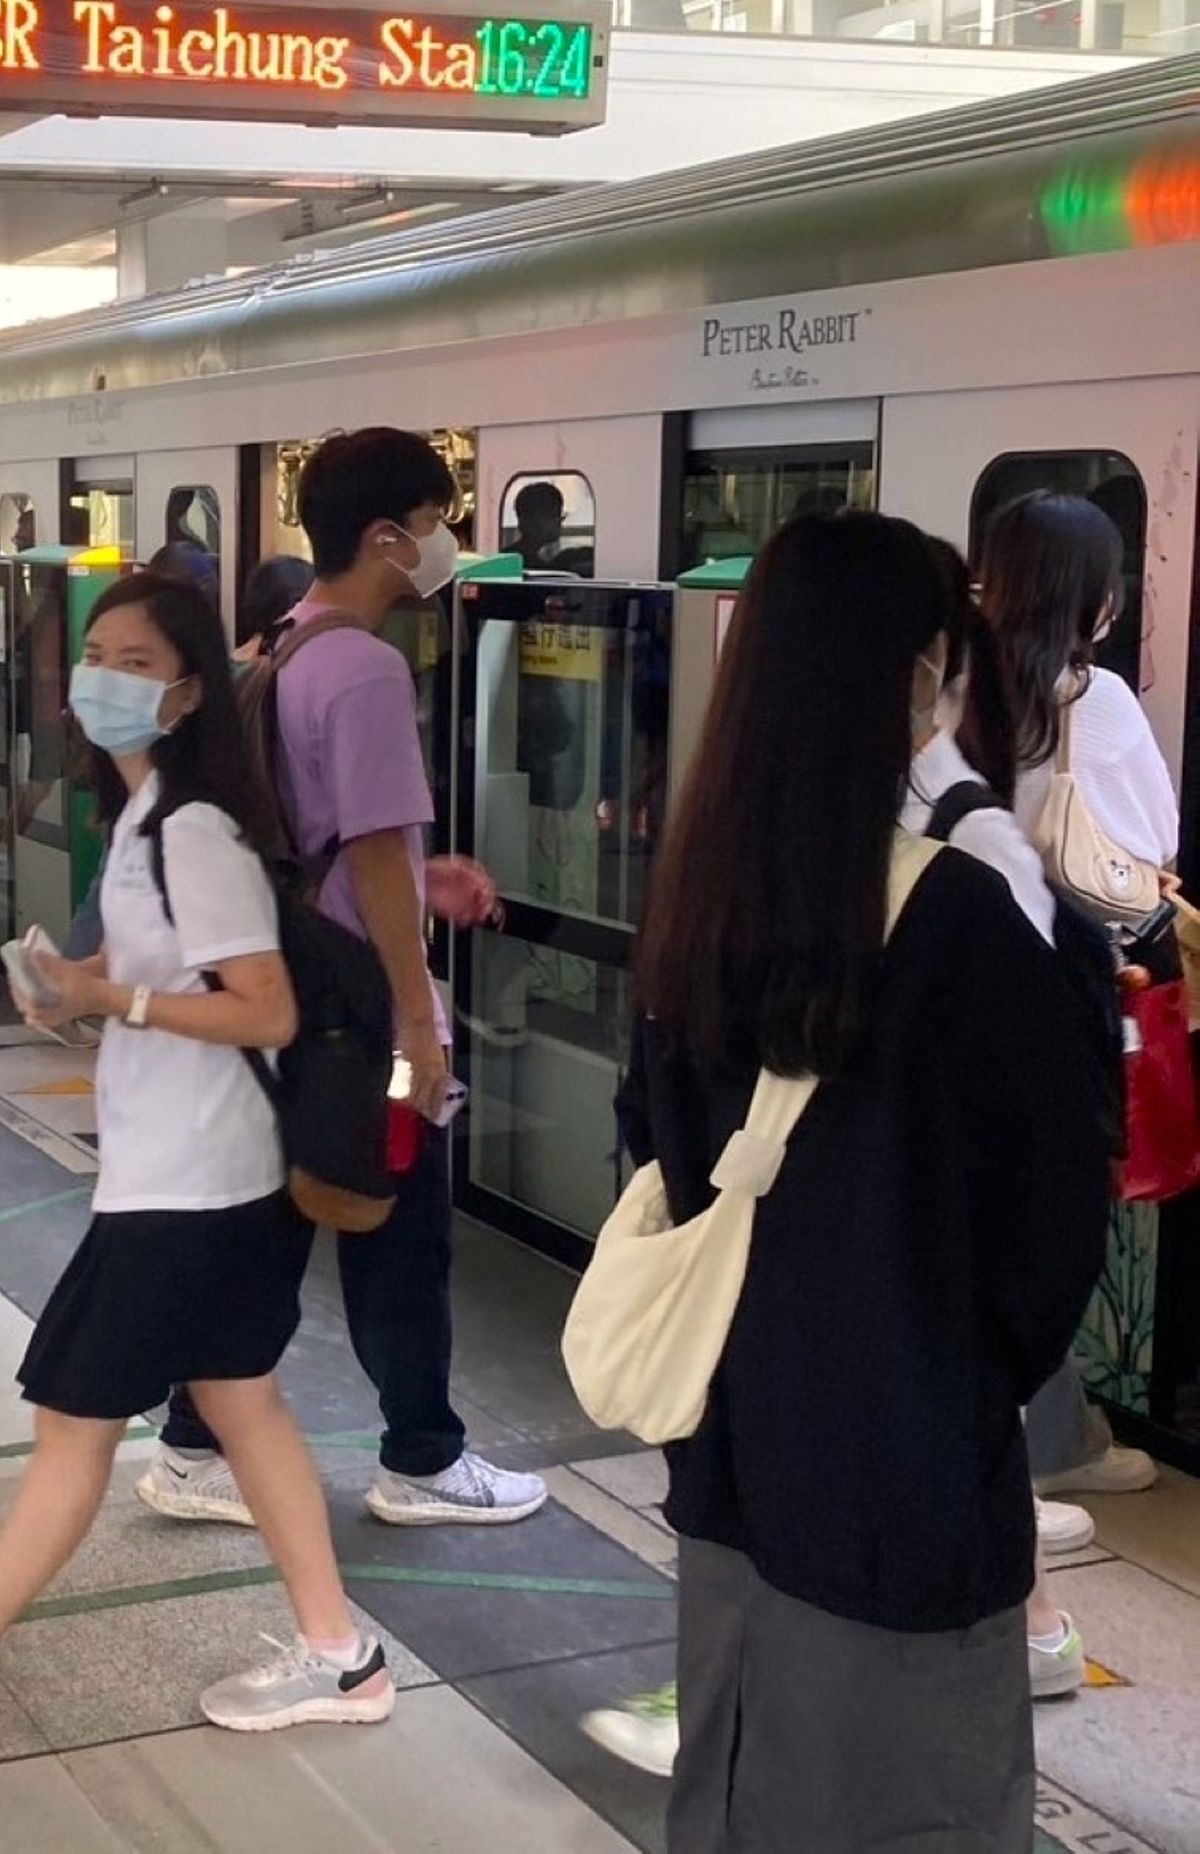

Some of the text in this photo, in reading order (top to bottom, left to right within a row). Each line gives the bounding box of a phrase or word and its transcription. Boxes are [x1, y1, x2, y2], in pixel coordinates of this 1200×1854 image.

[73, 1, 349, 89] Taichung
[379, 18, 475, 87] Sta
[474, 20, 586, 96] 16:24
[703, 308, 860, 357] PETER RABBIT
